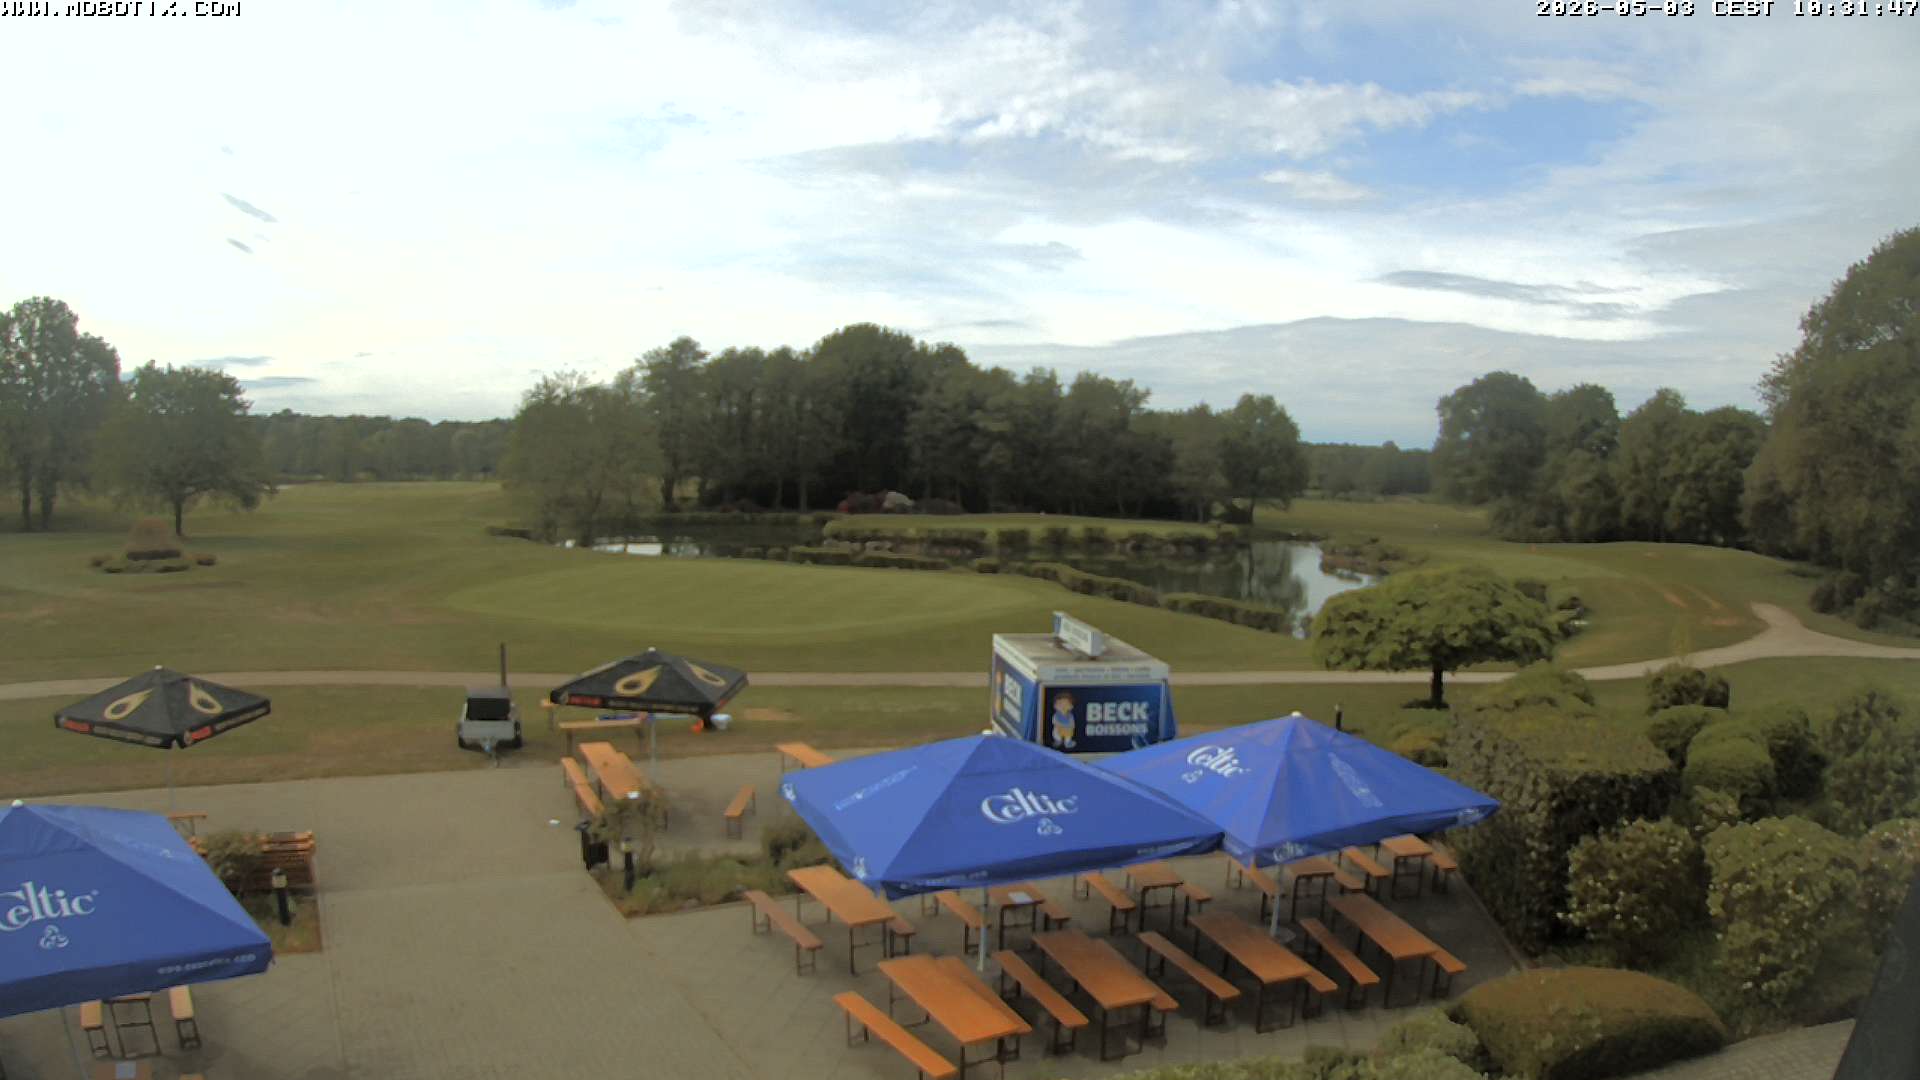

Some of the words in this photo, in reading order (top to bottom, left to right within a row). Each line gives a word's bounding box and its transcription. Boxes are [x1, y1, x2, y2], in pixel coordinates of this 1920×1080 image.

[1086, 701, 1149, 722] BECK
[1085, 723, 1148, 736] BOISSONS
[1186, 745, 1244, 778] Celtic
[981, 787, 1078, 824] Celtic
